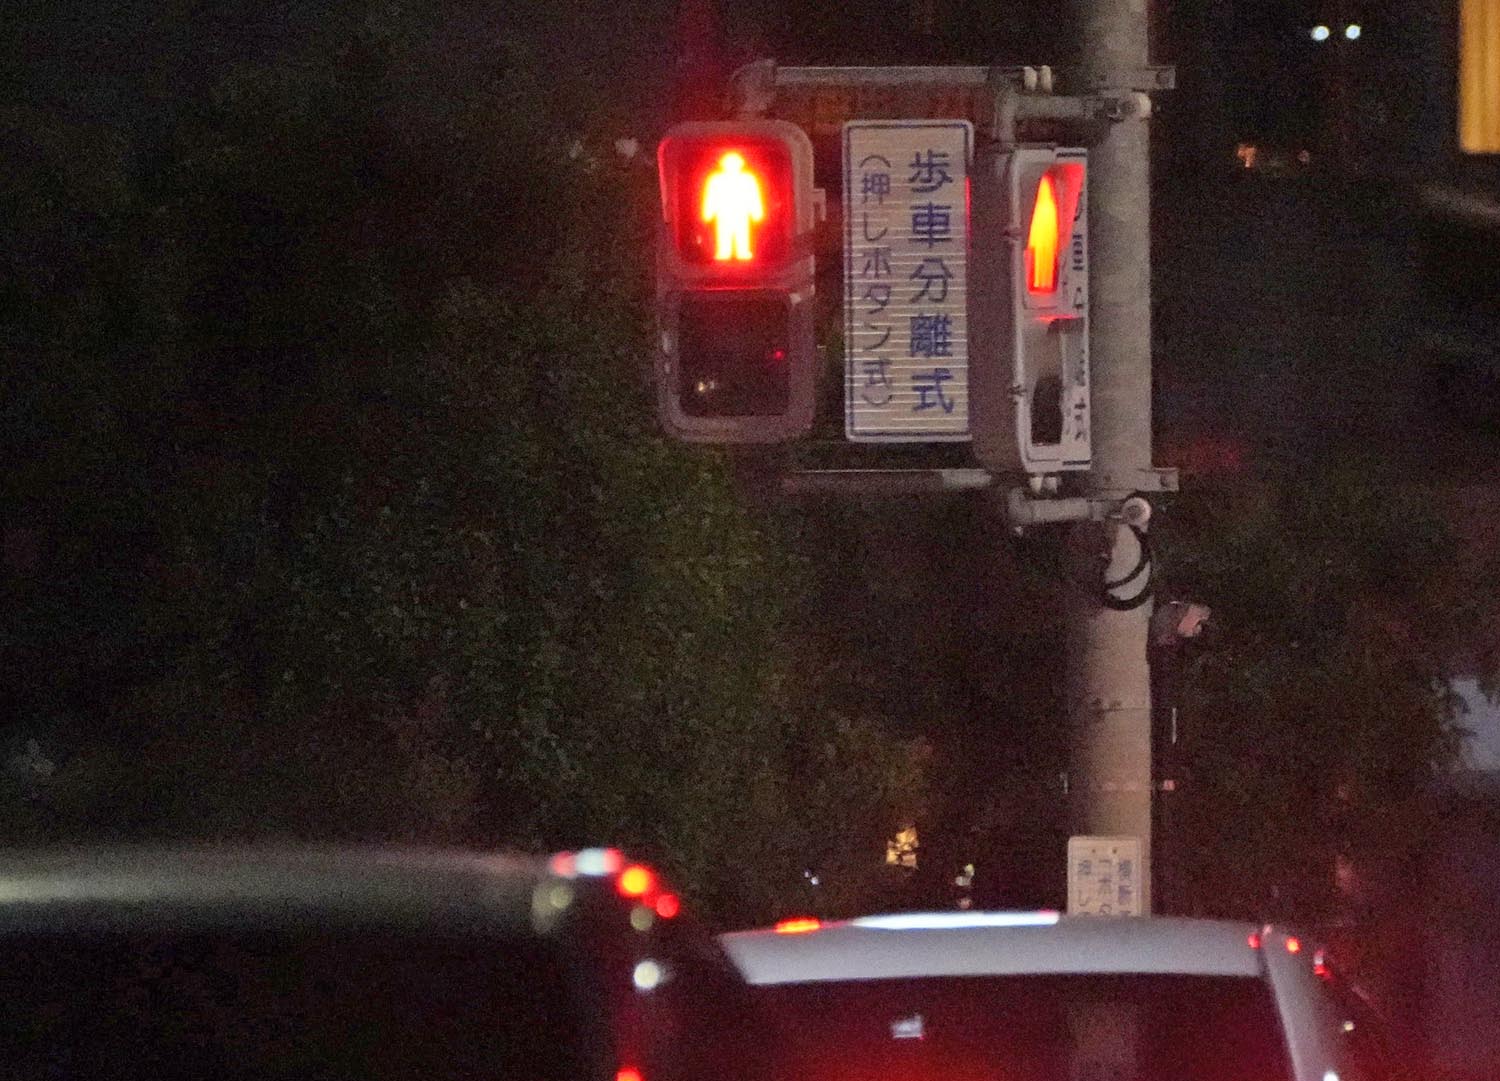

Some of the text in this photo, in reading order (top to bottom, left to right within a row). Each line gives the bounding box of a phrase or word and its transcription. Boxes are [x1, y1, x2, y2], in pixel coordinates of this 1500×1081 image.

[908, 149, 954, 413] 歩車分離式
